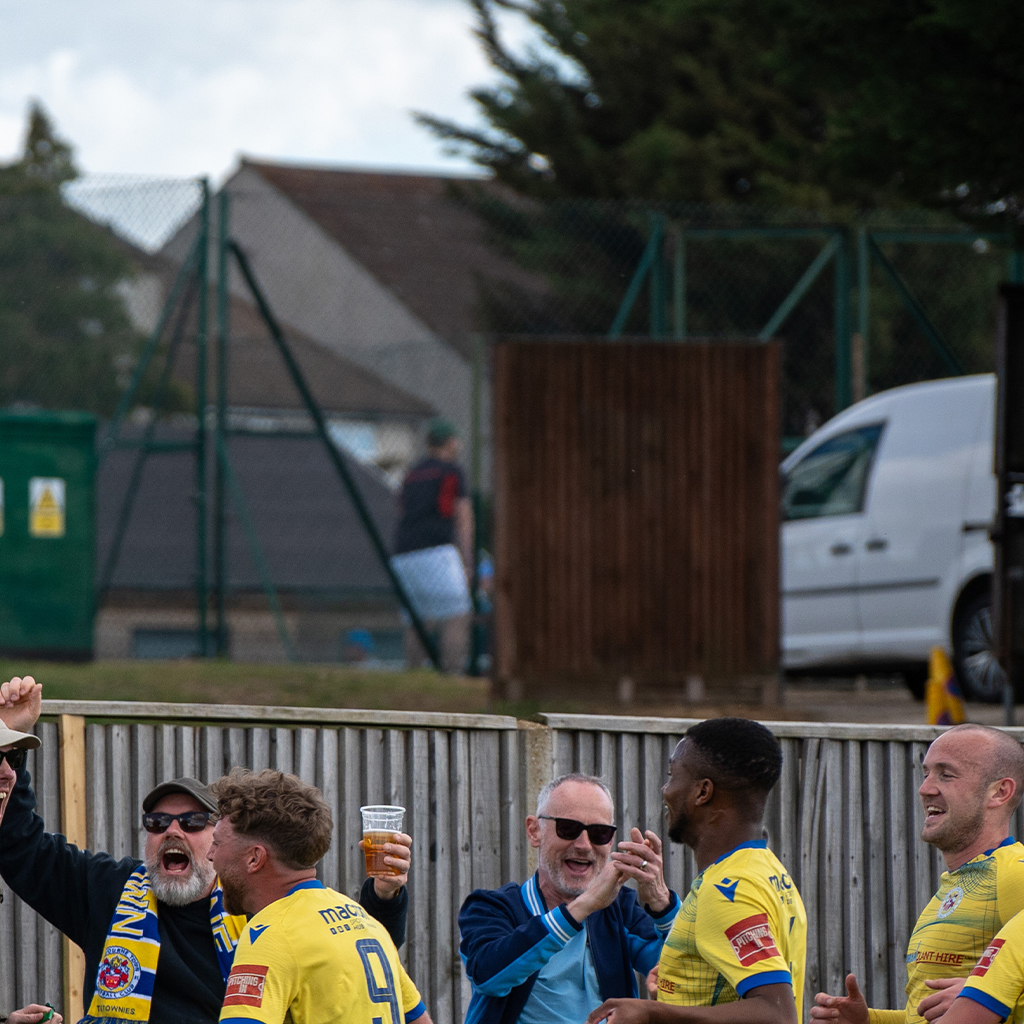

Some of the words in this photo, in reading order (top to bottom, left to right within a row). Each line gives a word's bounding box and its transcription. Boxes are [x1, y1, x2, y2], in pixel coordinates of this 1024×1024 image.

[736, 926, 768, 948] PITCHING
[936, 952, 964, 964] HIRE
[229, 975, 259, 987] PITCHING
